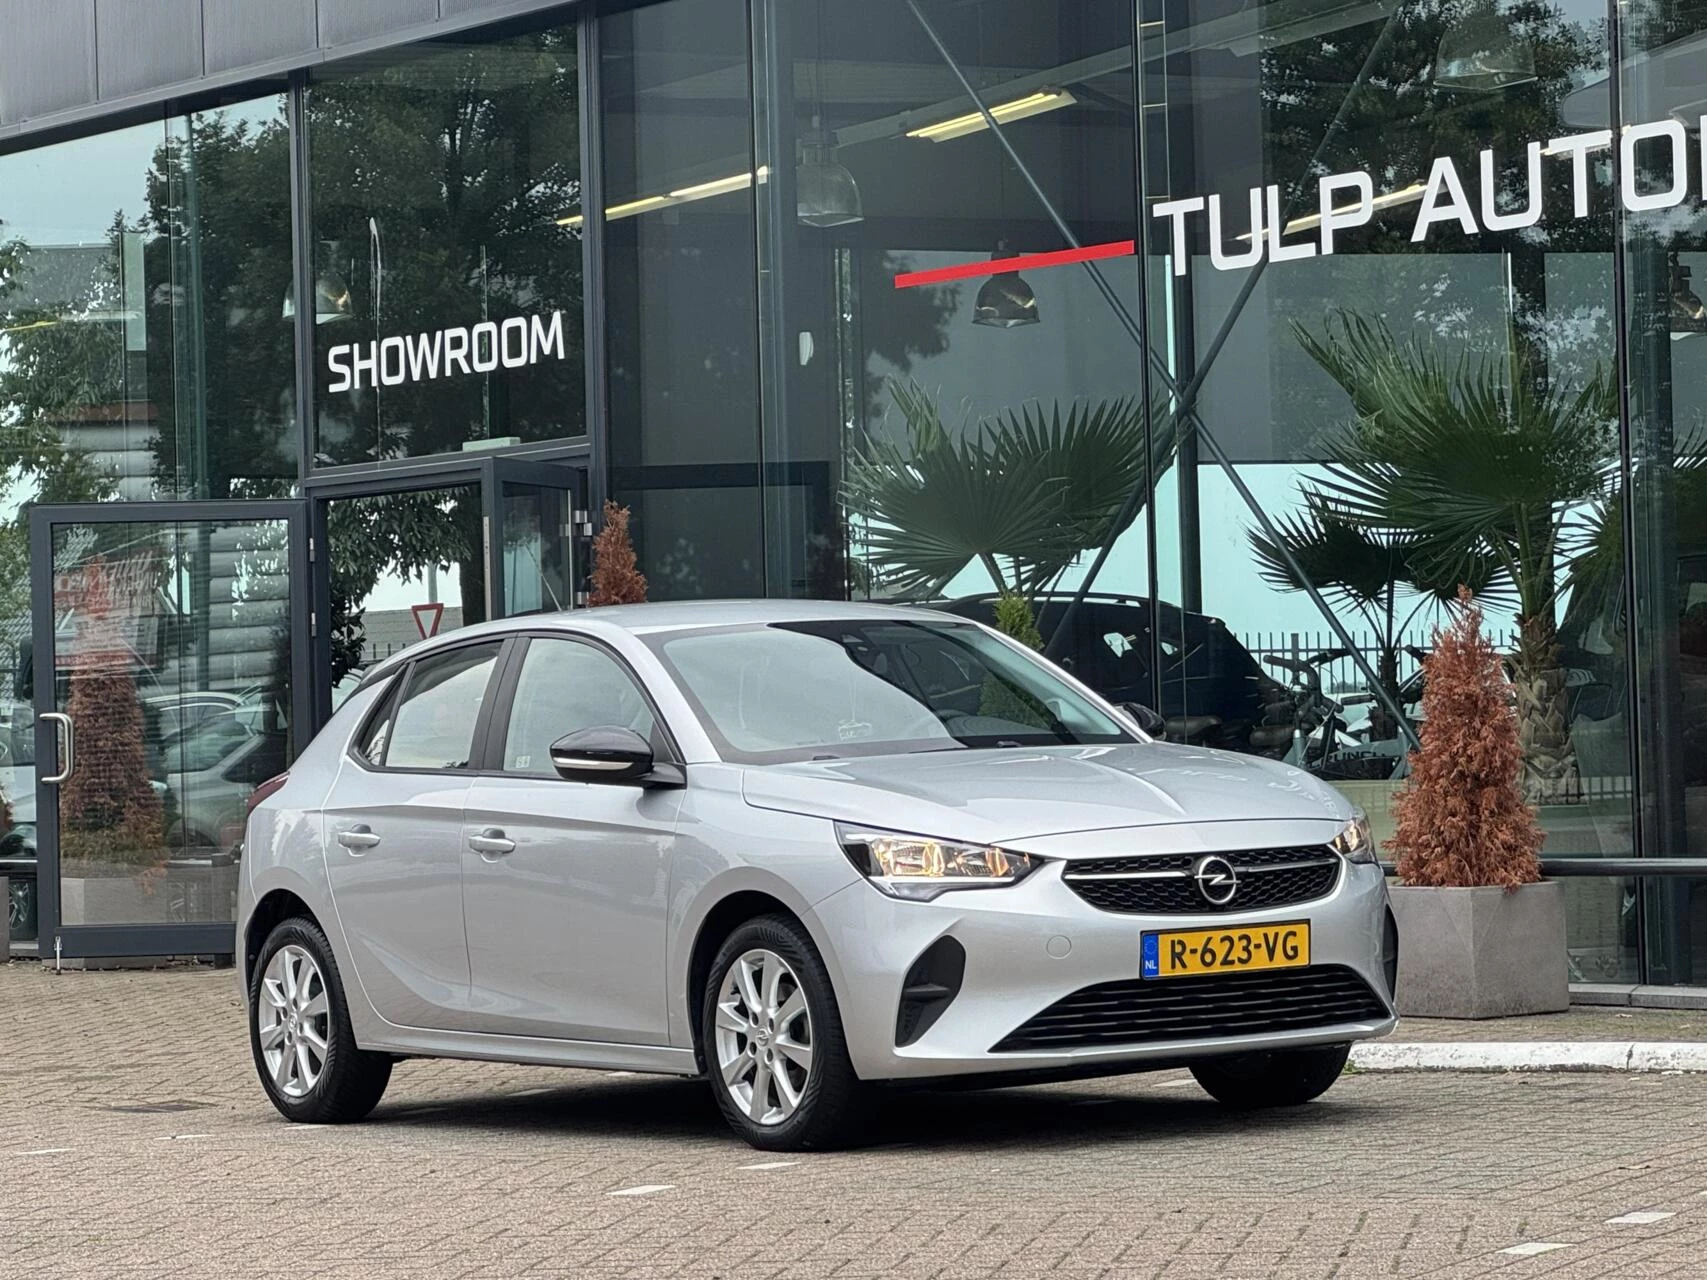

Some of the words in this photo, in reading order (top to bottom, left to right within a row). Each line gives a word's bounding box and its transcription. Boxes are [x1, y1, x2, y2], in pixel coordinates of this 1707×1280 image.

[1153, 171, 1373, 276] TULP
[1411, 115, 1707, 243] AUTO
[328, 311, 566, 393] SHOWROOM
[1145, 959, 1157, 970] NL
[1170, 930, 1299, 970] R-623-VG
